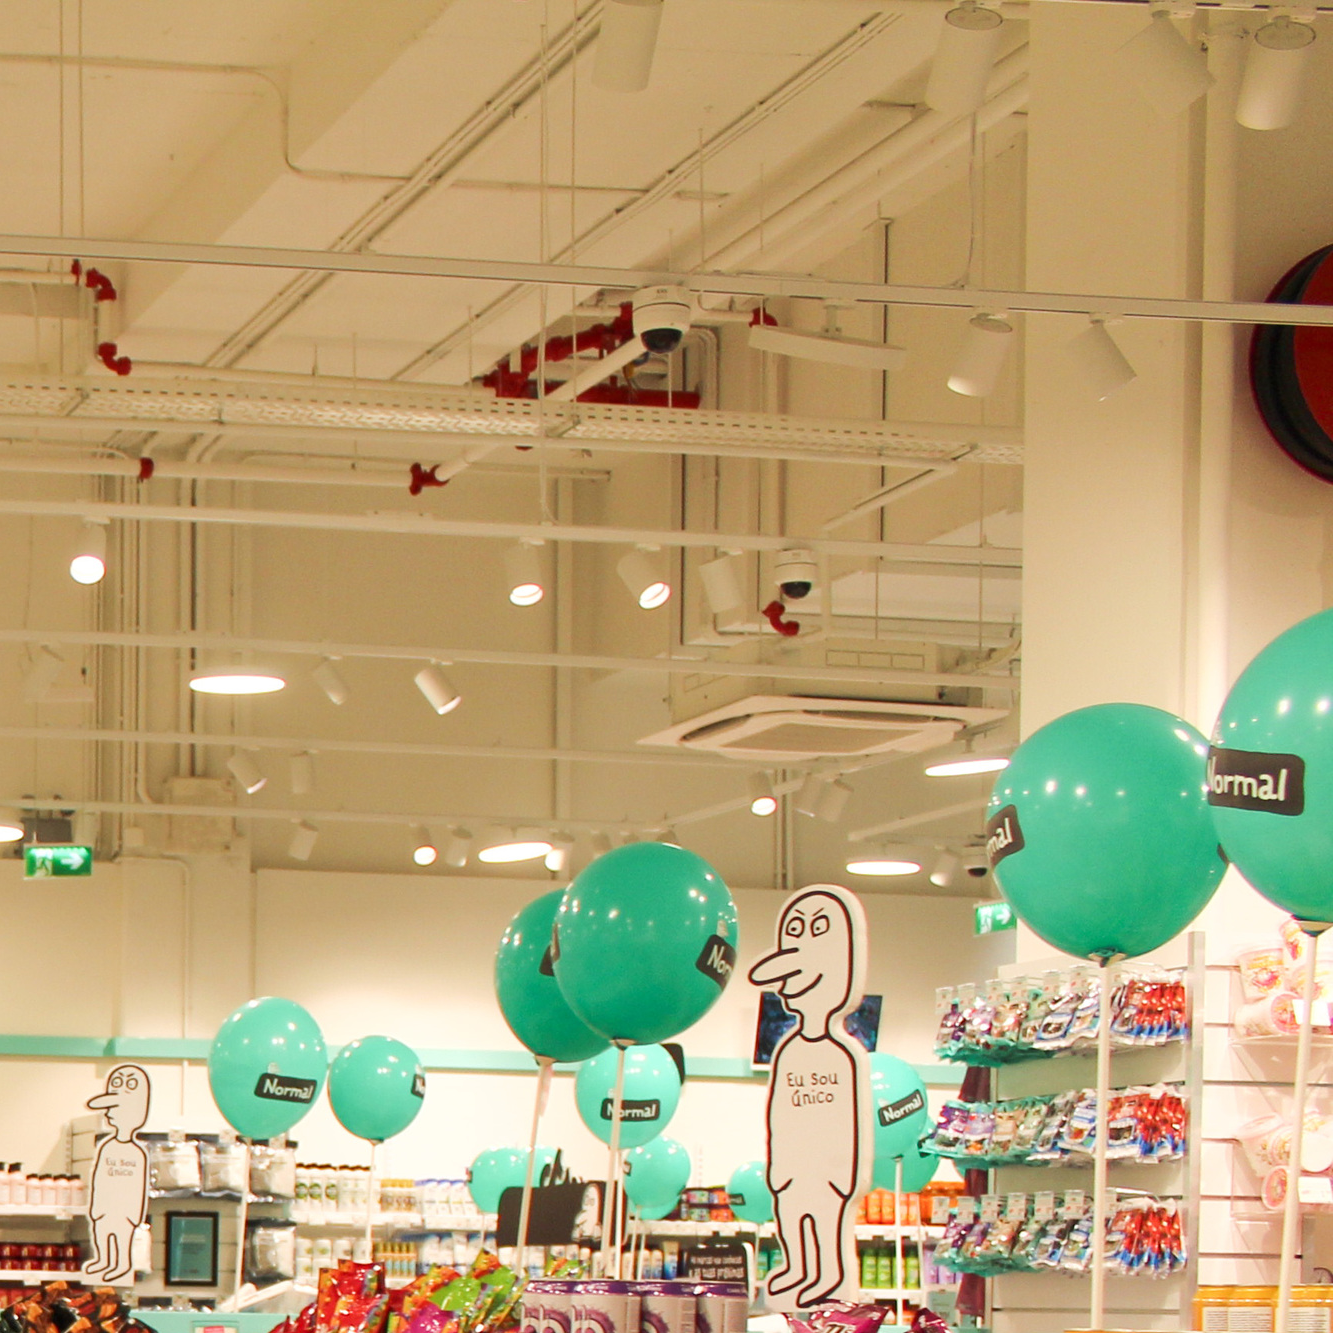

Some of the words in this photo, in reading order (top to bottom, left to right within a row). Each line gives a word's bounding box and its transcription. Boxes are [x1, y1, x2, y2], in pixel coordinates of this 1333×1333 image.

[787, 1072, 806, 1088] Eu
[263, 1081, 315, 1102] Normal
[792, 1088, 835, 1107] único
[883, 1093, 923, 1122] Normal
